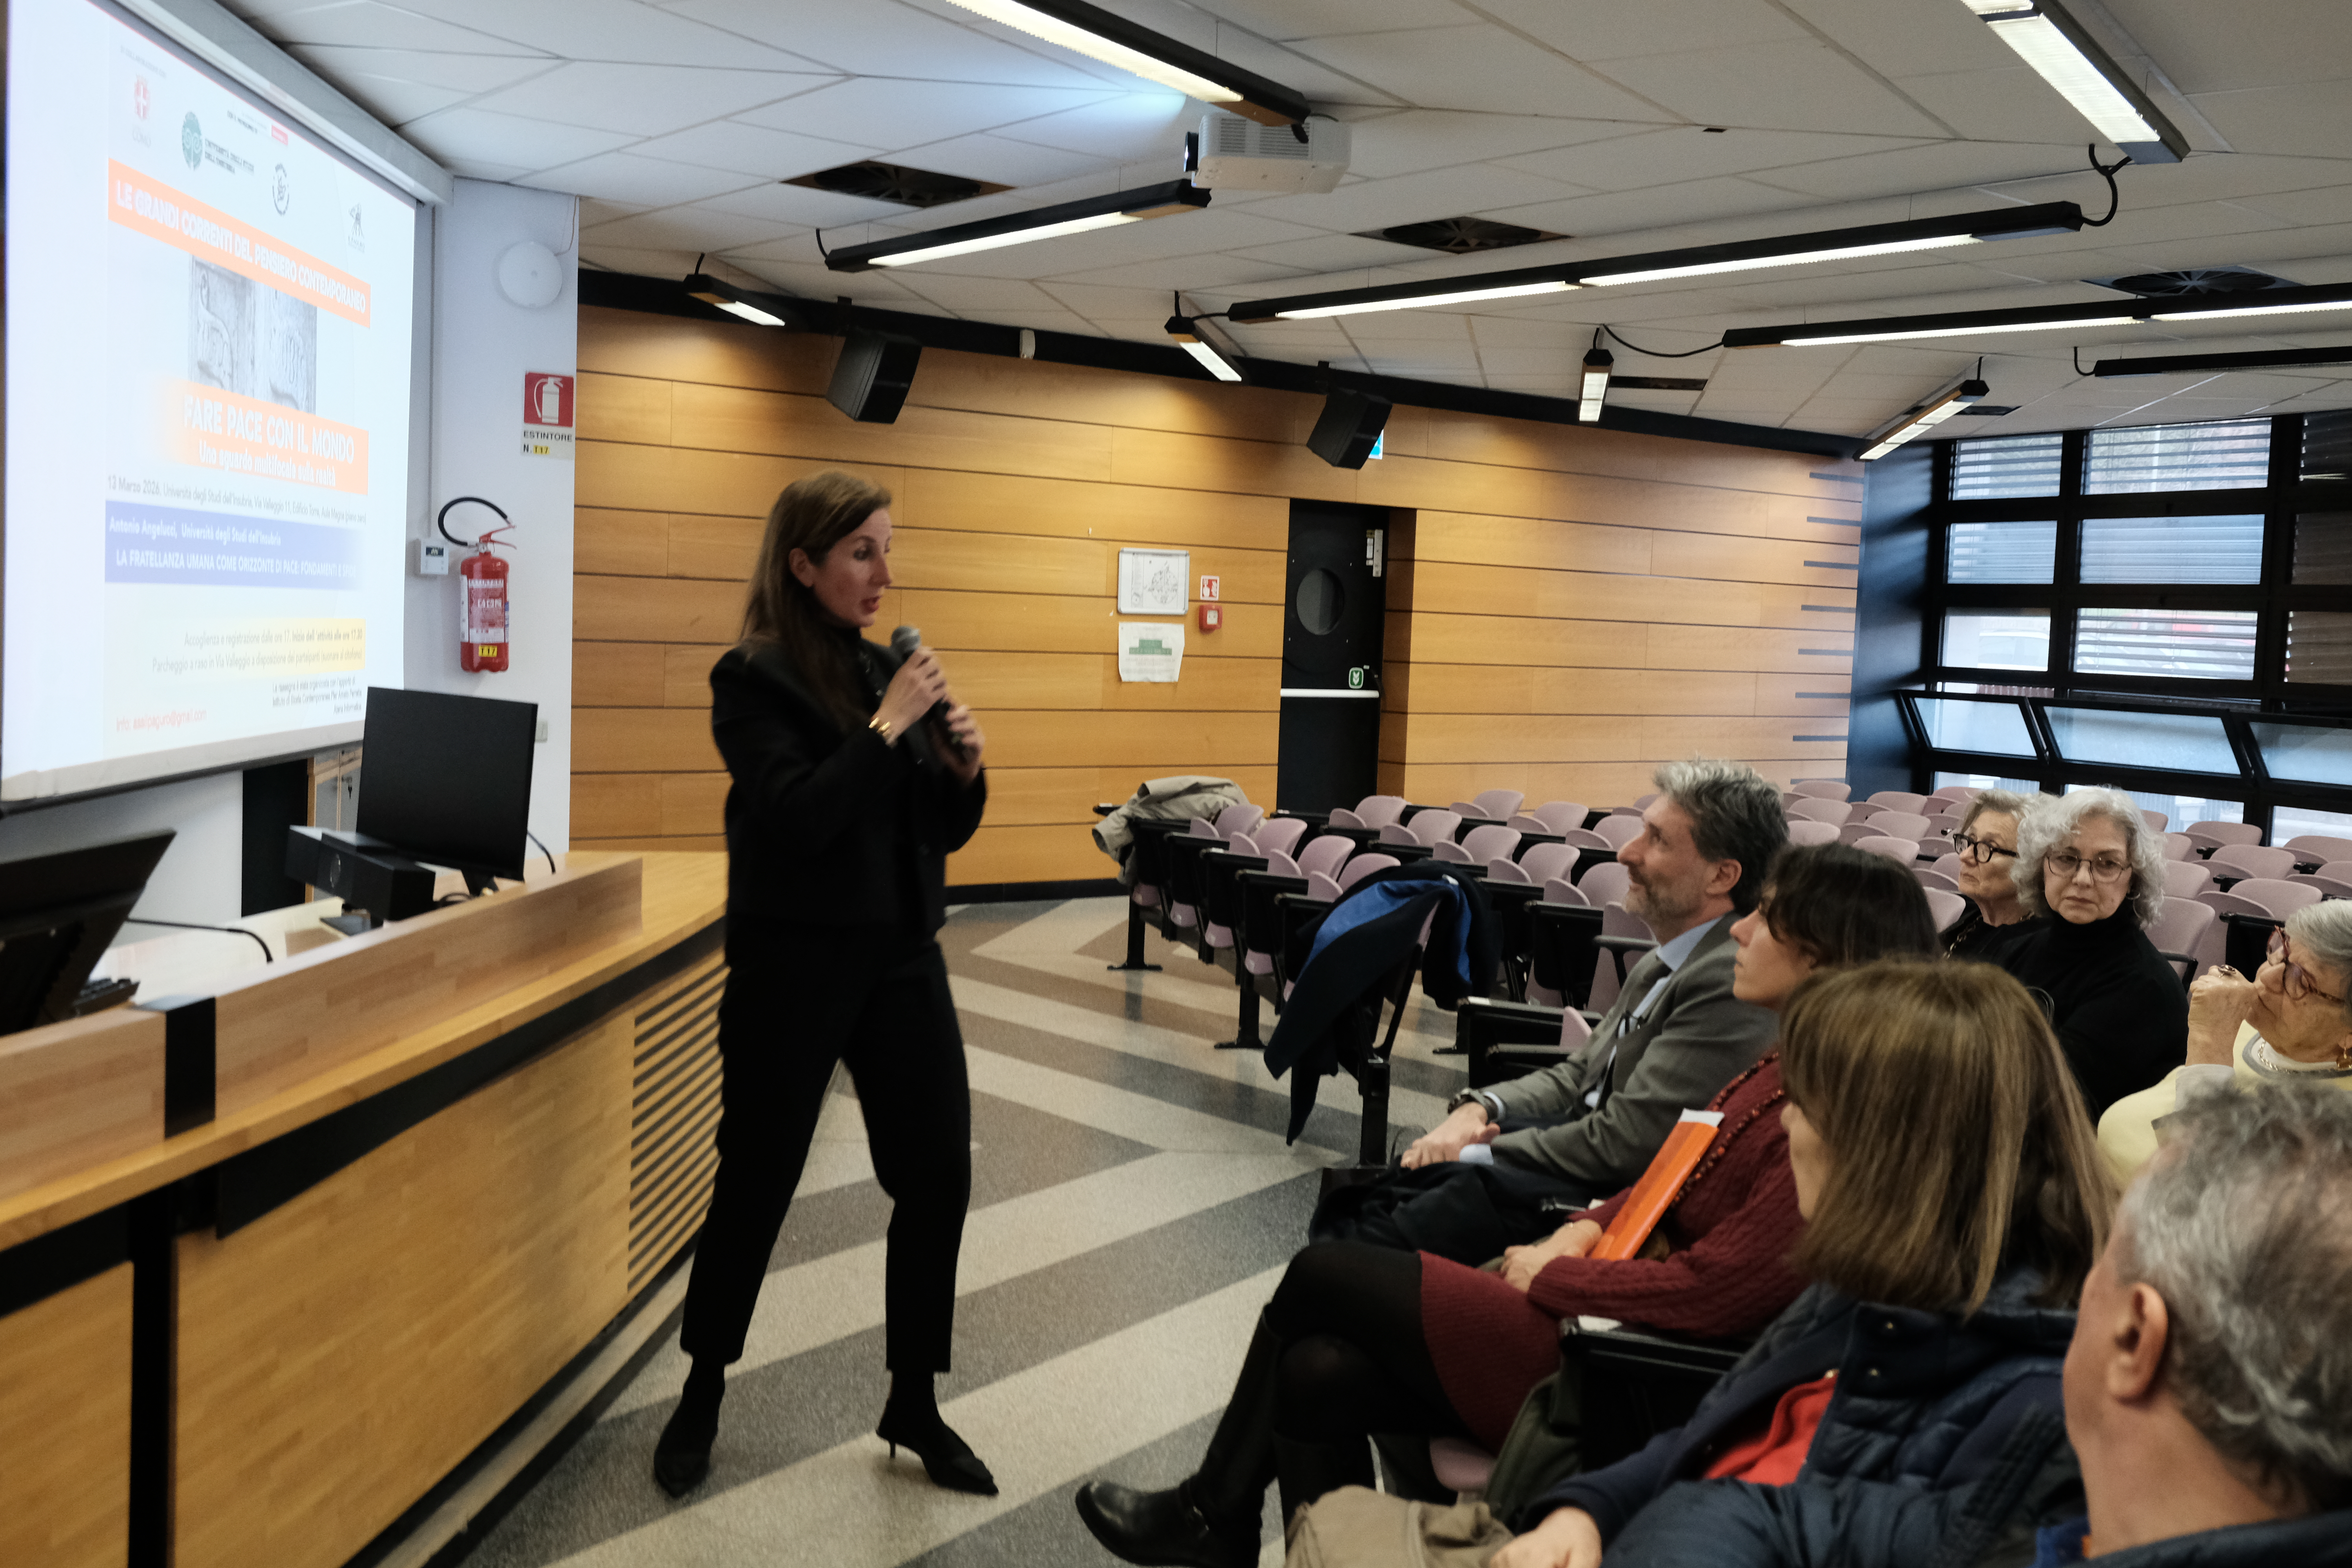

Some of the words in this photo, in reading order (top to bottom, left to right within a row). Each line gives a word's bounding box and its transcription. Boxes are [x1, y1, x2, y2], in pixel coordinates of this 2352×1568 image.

[116, 180, 133, 211] LE
[134, 189, 179, 230] GRANDI
[181, 209, 233, 254] CORRENTI
[234, 233, 253, 263] DEL
[254, 243, 297, 283] PENSIERO
[298, 264, 366, 314] CONTEMPORANEO
[184, 394, 222, 435] FARE
[227, 405, 262, 443] PACE
[267, 415, 293, 450] CON
[297, 423, 309, 453] IL
[312, 426, 354, 465] MONDO
[524, 430, 572, 443] ESTINTORE
[199, 439, 217, 465] Uno
[219, 447, 253, 472] sguardo
[254, 452, 296, 479] multifocale
[298, 460, 314, 483] sulla
[316, 465, 336, 487] realtà
[108, 475, 116, 490] 13
[118, 477, 141, 493] Marzo
[163, 483, 192, 500] Università
[193, 486, 207, 505] degli
[208, 488, 221, 504] Studi
[222, 490, 253, 510] dell'Insubria,
[263, 496, 284, 515] Valleggio
[292, 500, 309, 515] Edificio
[309, 503, 320, 519] Torre,
[321, 506, 330, 519] Aula
[331, 507, 345, 523] Magna
[345, 510, 357, 525] (piano
[357, 512, 367, 526] zero)
[109, 515, 140, 534] Antonio
[141, 519, 177, 540] Angelucci,
[181, 522, 214, 540] Università
[215, 526, 230, 546] degli
[232, 526, 247, 543] Studi
[248, 529, 281, 546] dell'Insubria
[116, 548, 127, 567] LA
[129, 549, 185, 569] FRATELLANZA
[187, 552, 215, 570] UMANA
[216, 554, 236, 572] COME
[238, 555, 274, 573] ORIZZONTE
[276, 558, 282, 574] DI
[283, 558, 299, 575] PACE:
[301, 559, 337, 577] FONDAMENTI
[338, 563, 341, 577] E
[342, 564, 356, 579] SFIDE
[184, 630, 219, 650] Accoglienza
[221, 637, 224, 645] e
[226, 630, 260, 649] registrazione
[261, 627, 273, 643] dalle
[274, 633, 282, 643] ore
[292, 628, 305, 642] Inizio
[351, 627, 363, 641] 17.30
[152, 656, 188, 675] Parcheggio
[190, 662, 193, 670] a
[195, 658, 207, 671] raso
[209, 655, 214, 669] in
[215, 653, 224, 669] Via
[225, 652, 250, 671] Valleggio
[252, 658, 255, 666] a
[256, 650, 286, 669] disposizione
[321, 649, 339, 663] (suonare
[340, 647, 344, 661] al
[344, 647, 362, 661] citofono)
